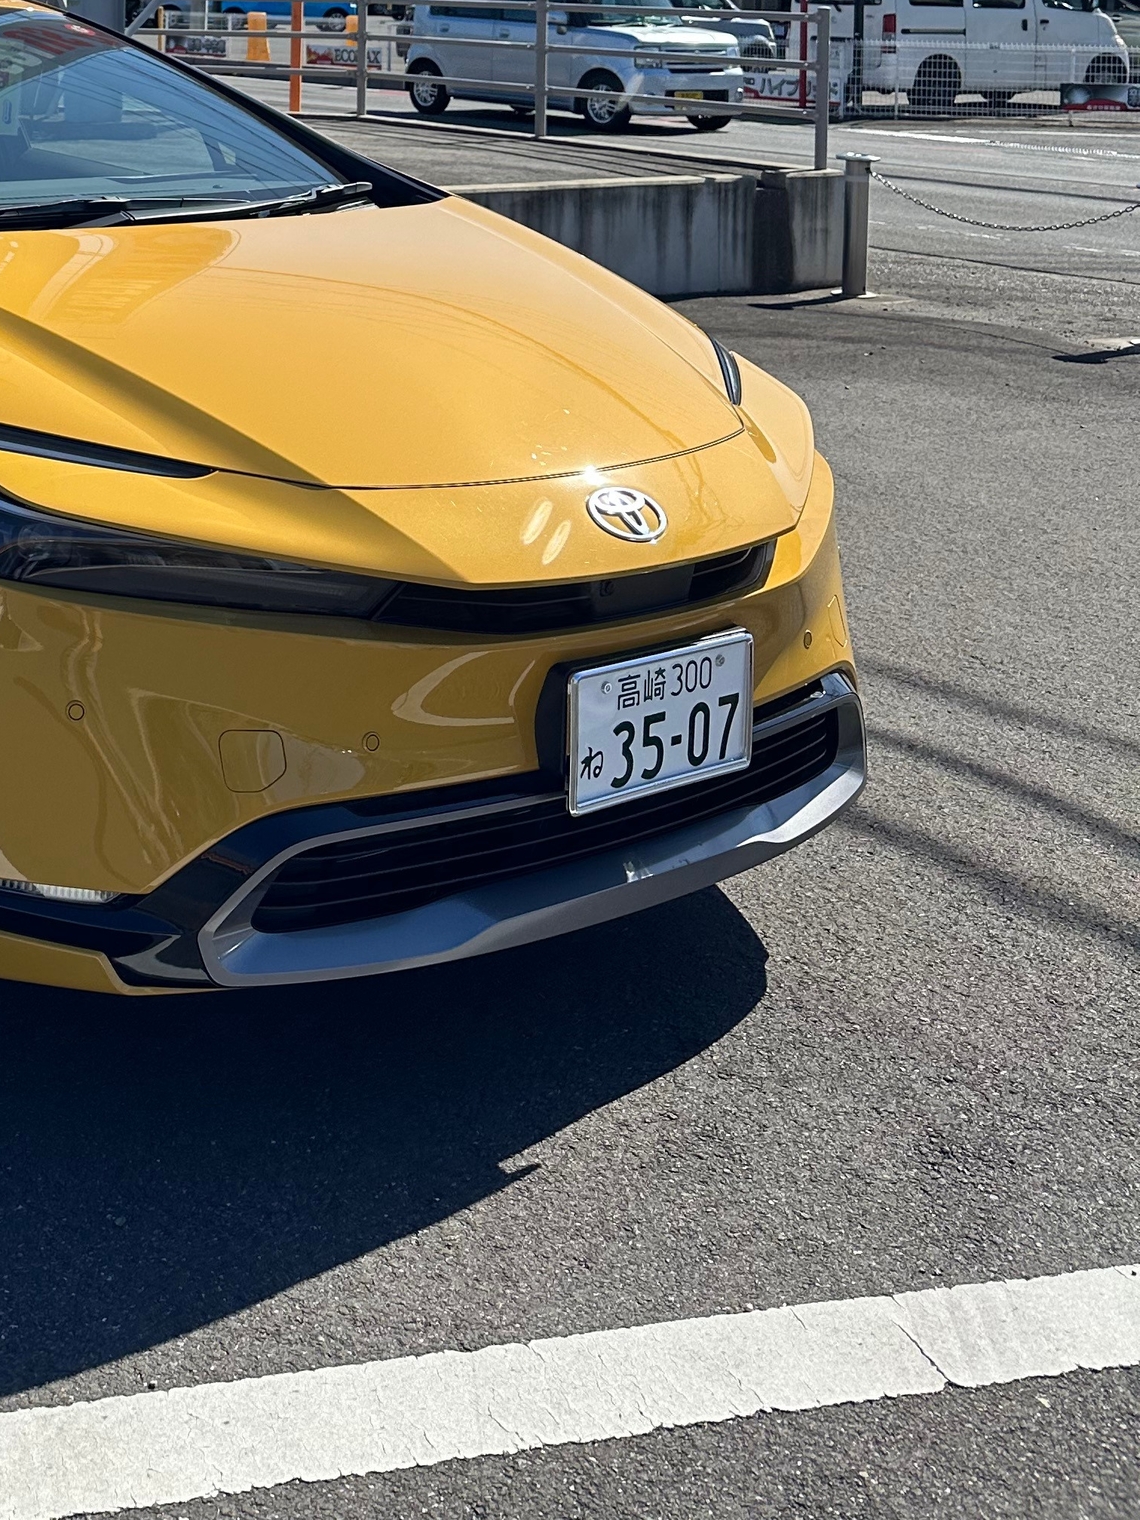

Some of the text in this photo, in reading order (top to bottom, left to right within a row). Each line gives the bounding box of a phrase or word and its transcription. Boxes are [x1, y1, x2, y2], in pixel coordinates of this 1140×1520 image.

[334, 49, 381, 64] ECOAX
[617, 656, 712, 710] 高崎 300
[580, 692, 740, 788] ね 35-07
